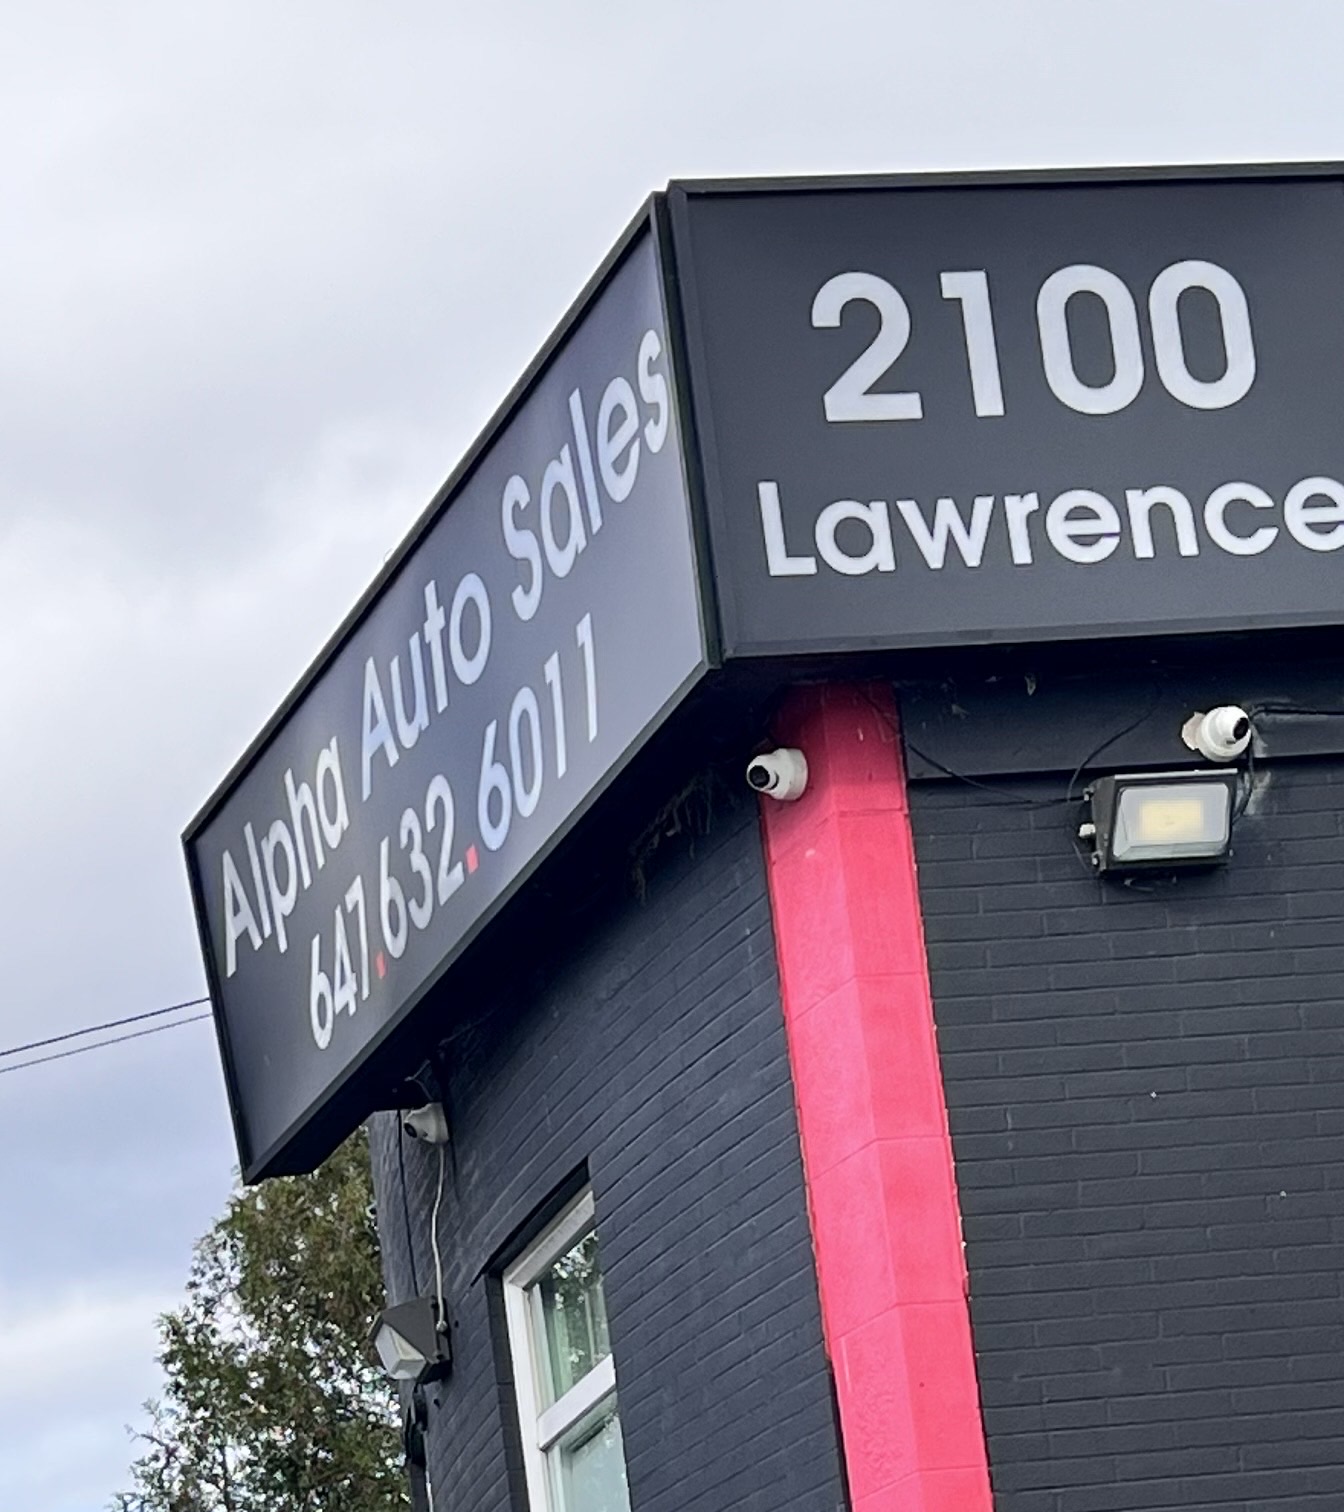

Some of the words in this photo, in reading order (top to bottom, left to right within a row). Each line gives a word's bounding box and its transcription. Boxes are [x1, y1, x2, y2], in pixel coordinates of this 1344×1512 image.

[812, 260, 1256, 422] 2100
[222, 735, 350, 979] Alpha
[361, 572, 493, 802] Auto
[501, 328, 669, 621] Sales
[309, 612, 598, 1051] 647.632.6011
